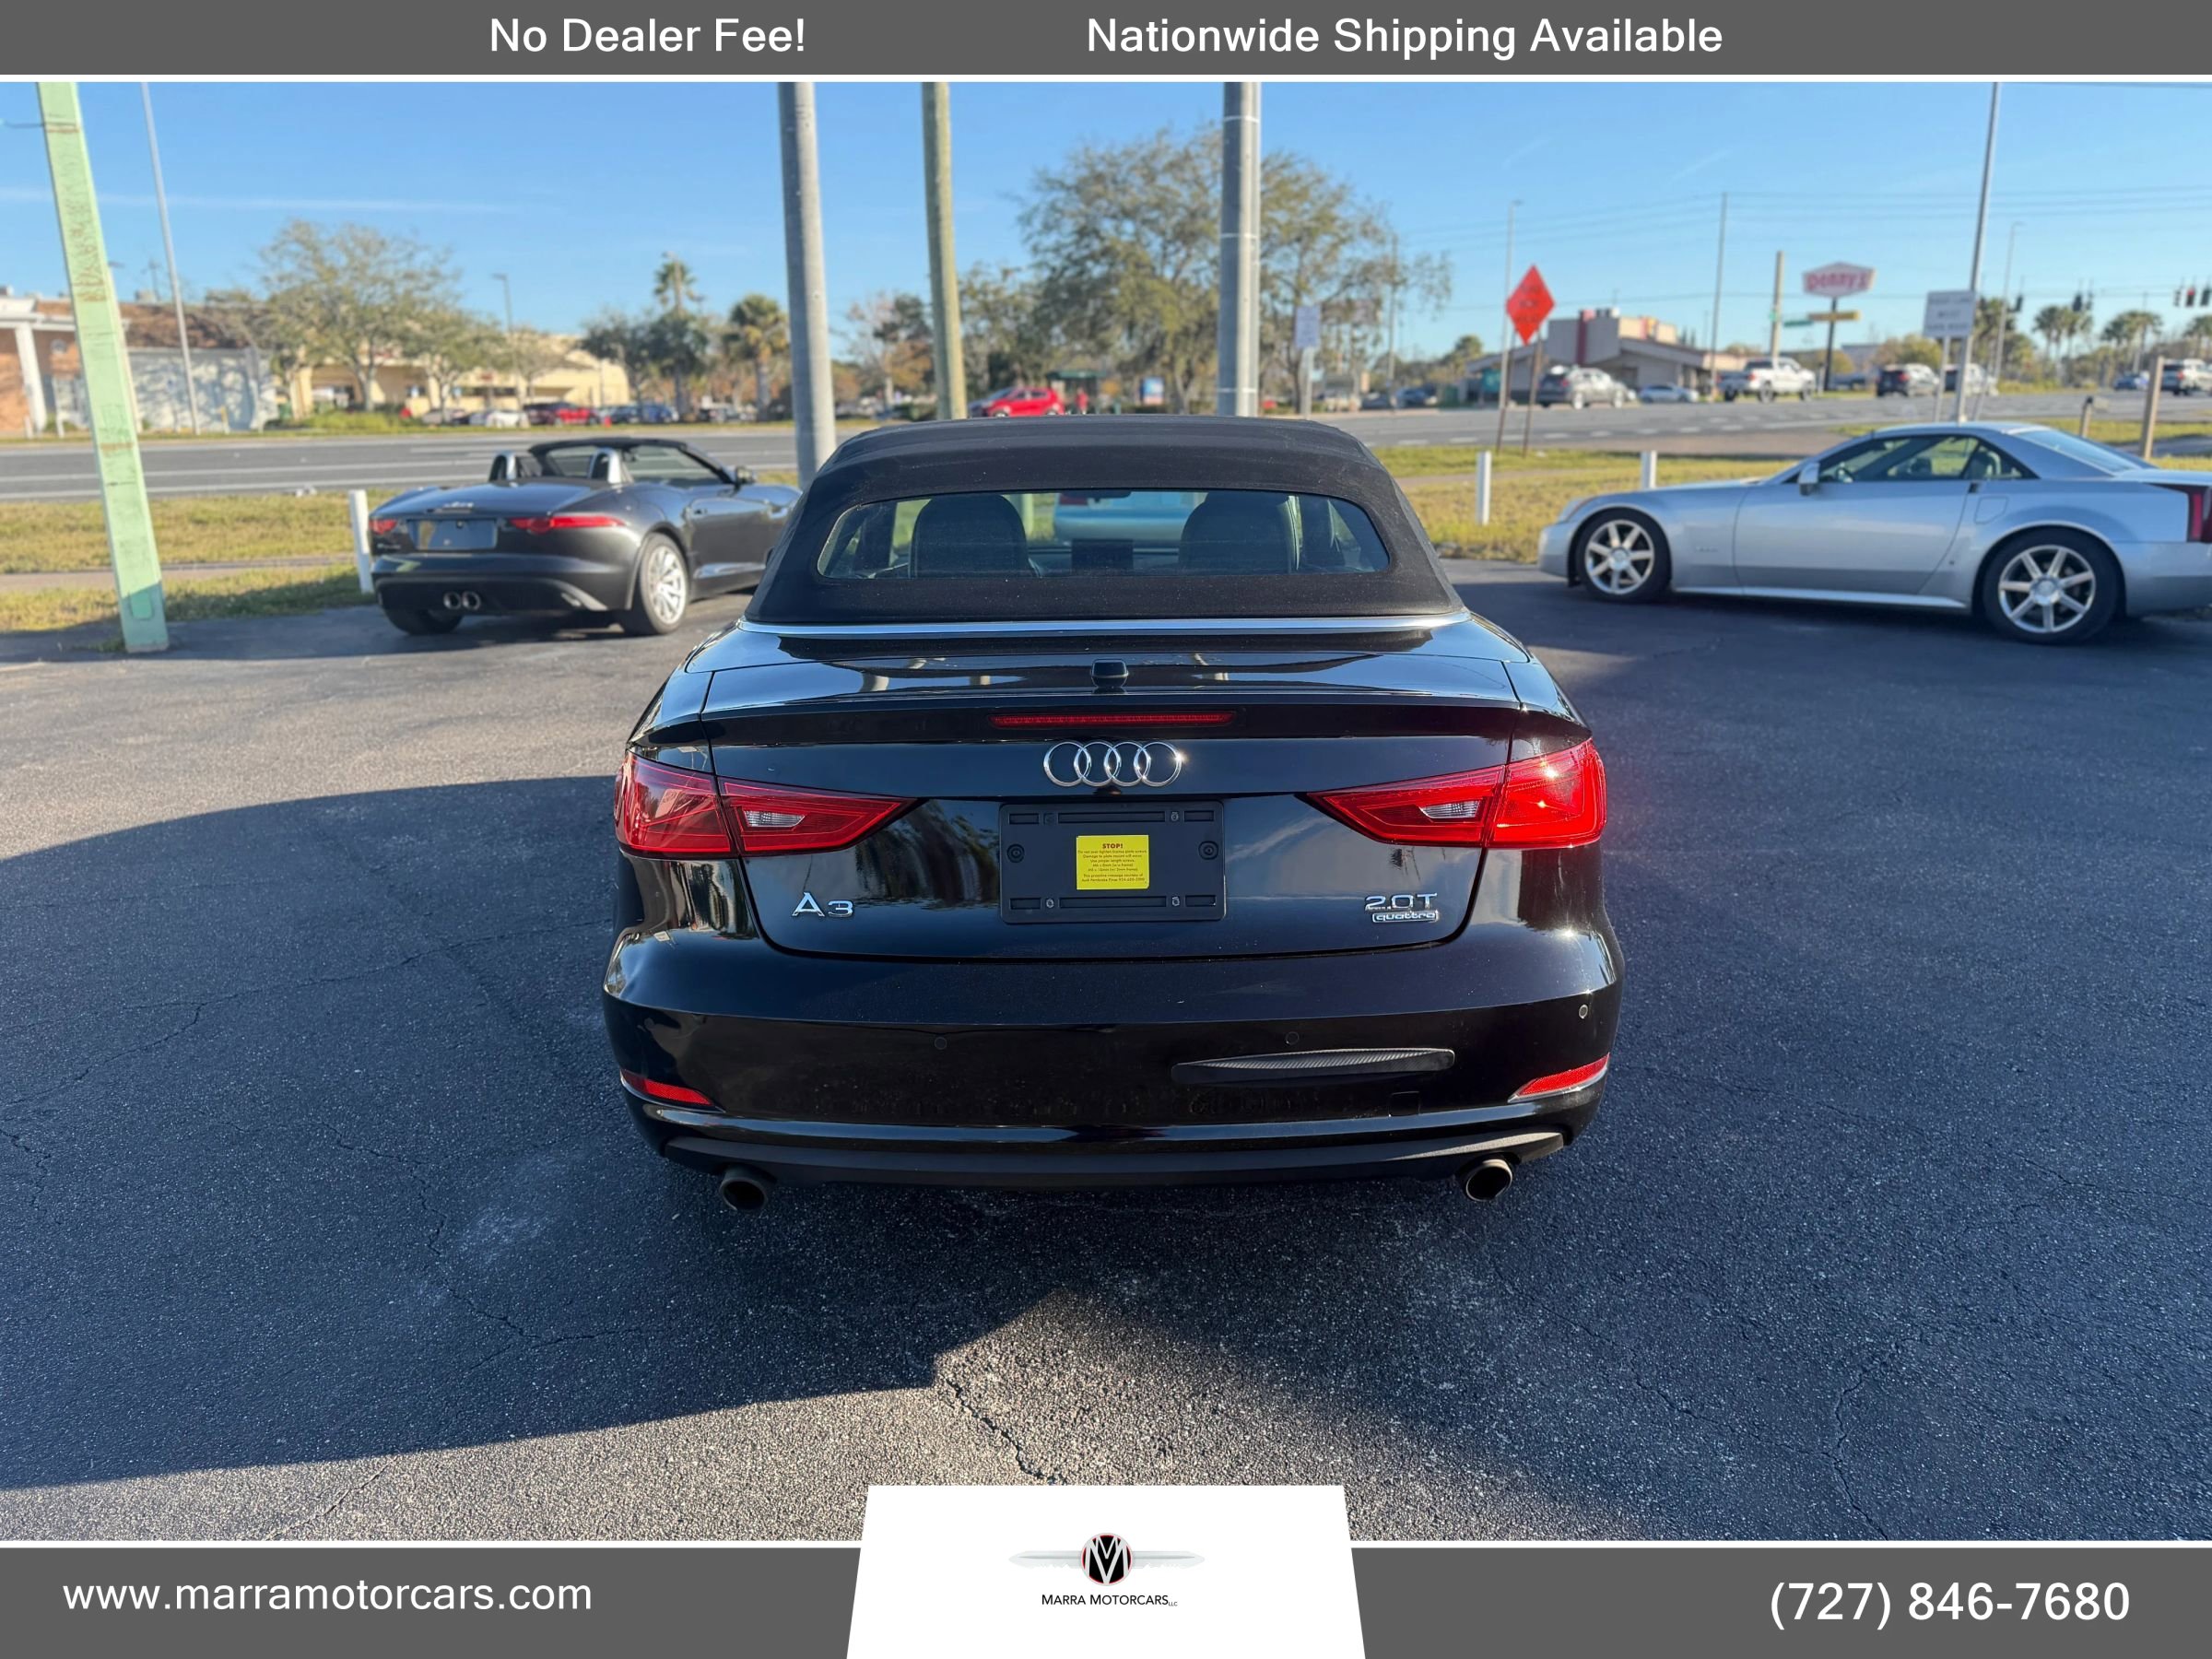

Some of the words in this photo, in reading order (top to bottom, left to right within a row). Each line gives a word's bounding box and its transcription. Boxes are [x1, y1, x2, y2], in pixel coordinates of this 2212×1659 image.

[792, 891, 853, 917] A3
[1365, 892, 1438, 911] 2.0T
[1375, 911, 1436, 921] quattro
